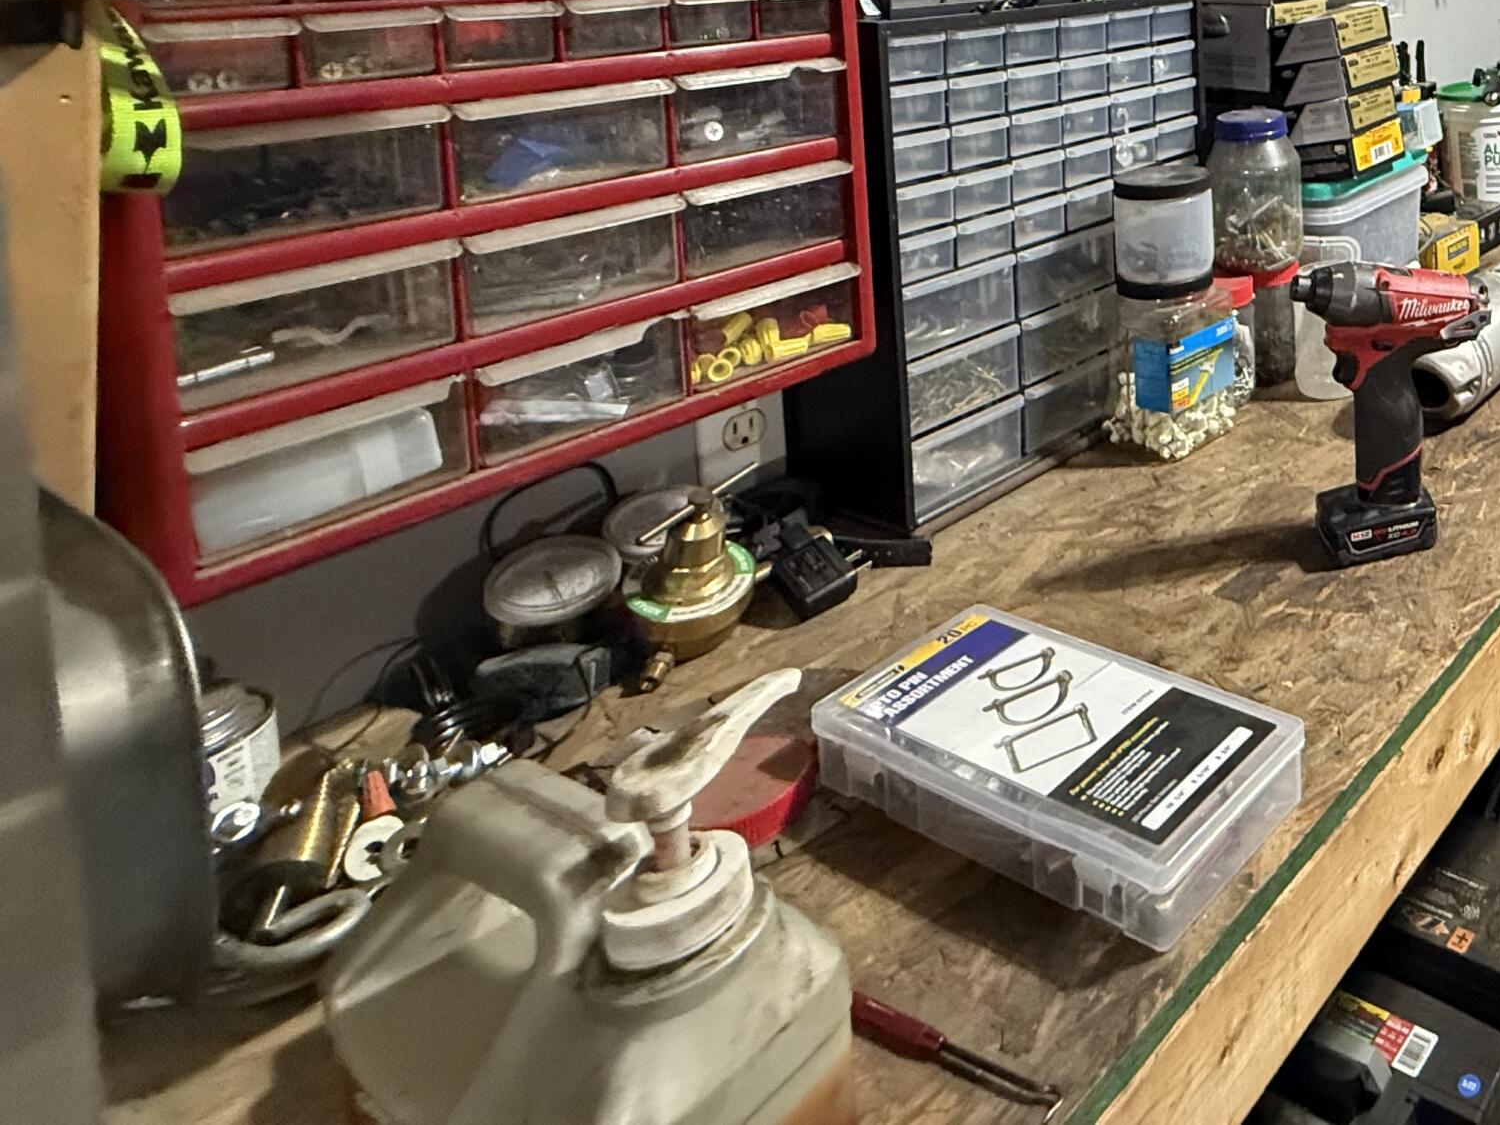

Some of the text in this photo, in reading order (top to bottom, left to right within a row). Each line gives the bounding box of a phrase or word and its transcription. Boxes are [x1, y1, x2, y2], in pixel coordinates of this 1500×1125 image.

[1399, 297, 1470, 320] Milwaukee
[936, 628, 962, 645] 20
[883, 655, 975, 717] ASSORTMENT
[898, 671, 929, 691] PIN
